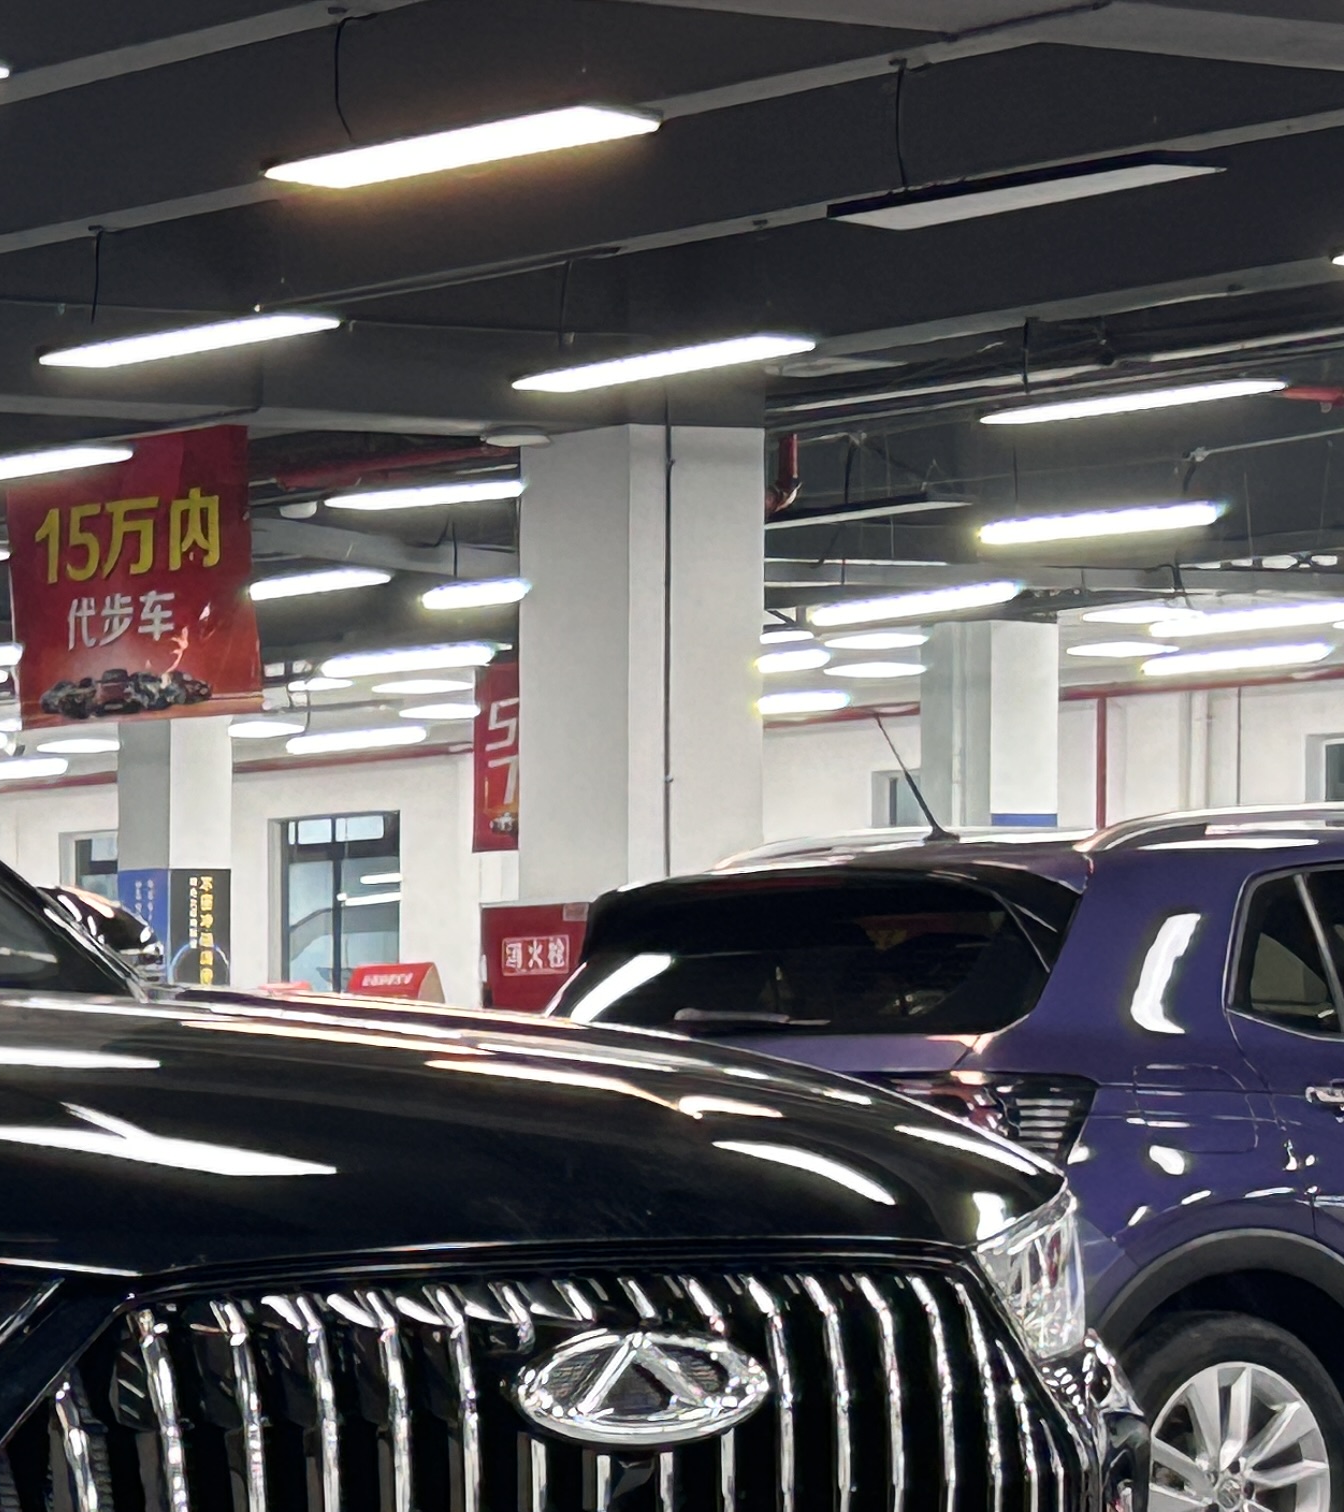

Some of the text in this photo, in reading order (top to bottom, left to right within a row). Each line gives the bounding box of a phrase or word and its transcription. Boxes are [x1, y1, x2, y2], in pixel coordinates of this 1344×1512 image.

[35, 487, 220, 585] 15万内
[67, 590, 175, 650] 代步车
